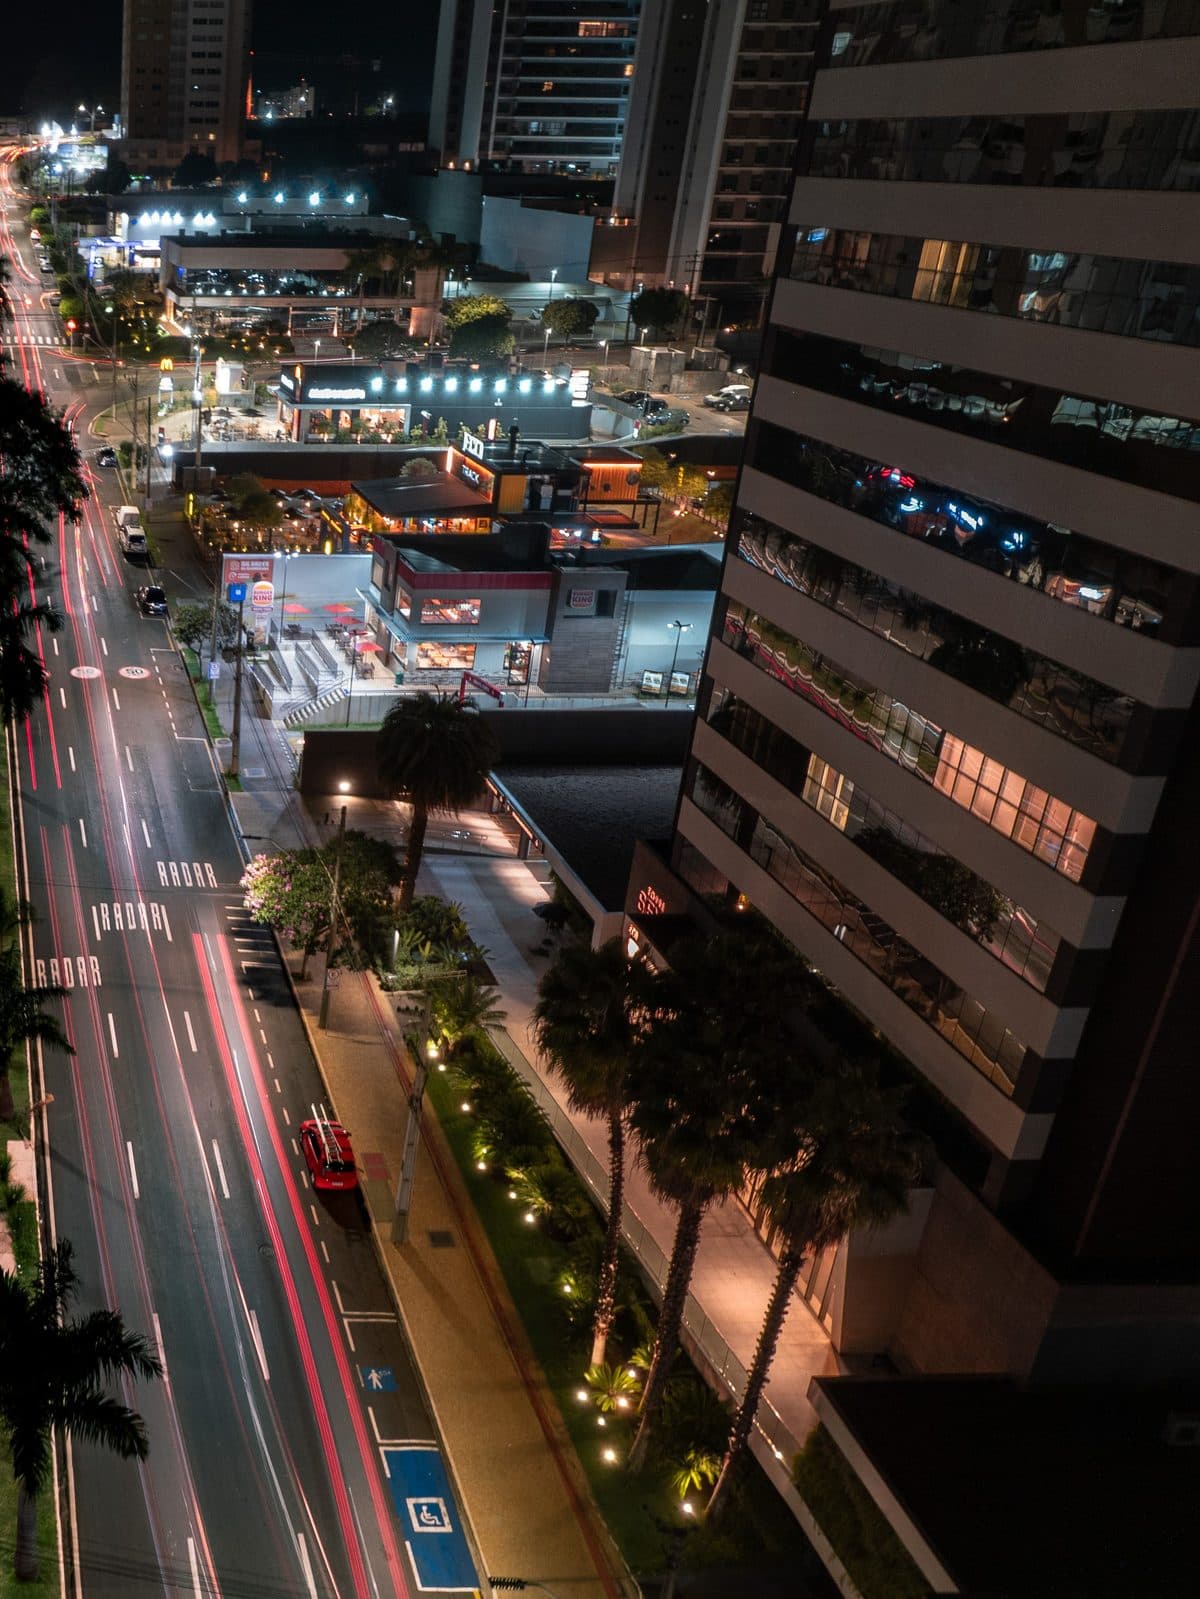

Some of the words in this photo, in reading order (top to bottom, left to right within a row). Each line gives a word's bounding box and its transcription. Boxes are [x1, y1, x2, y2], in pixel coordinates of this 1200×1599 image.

[157, 861, 218, 888] RADAR
[100, 902, 163, 931] RADAR
[36, 956, 102, 988] RADAR
